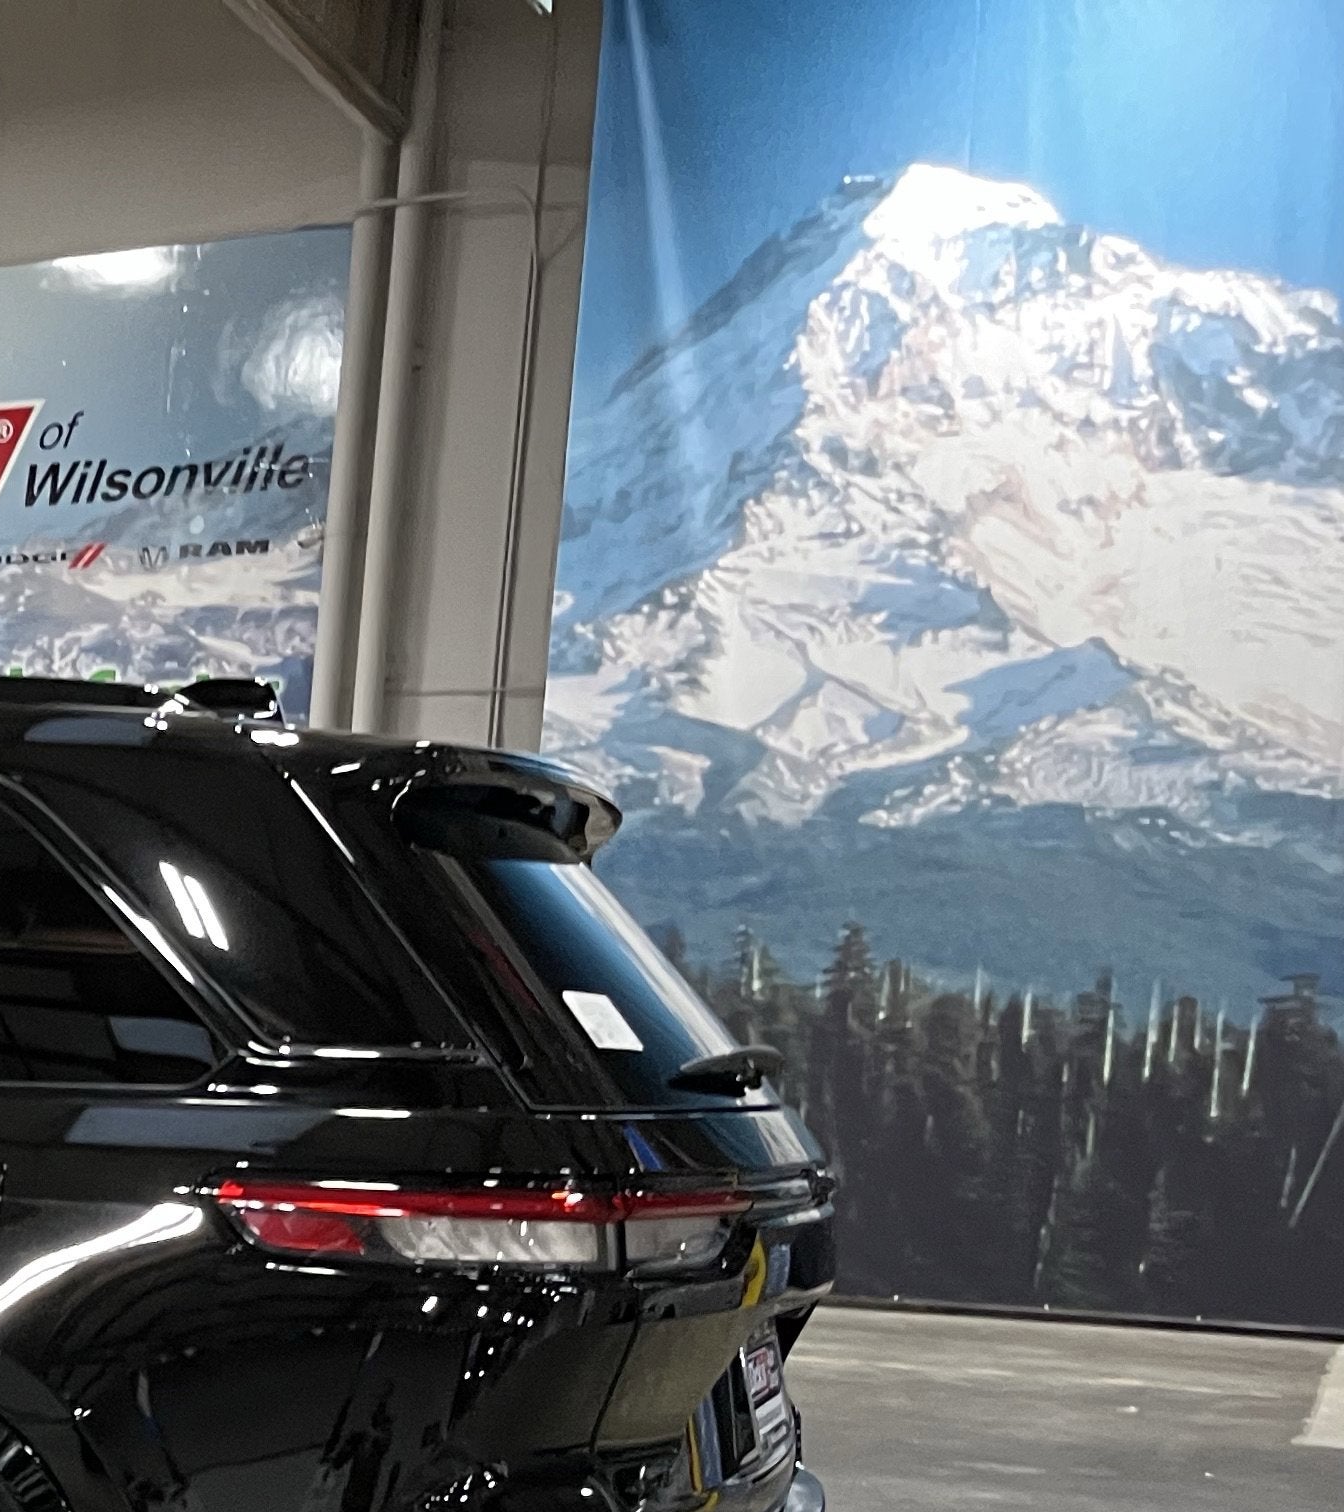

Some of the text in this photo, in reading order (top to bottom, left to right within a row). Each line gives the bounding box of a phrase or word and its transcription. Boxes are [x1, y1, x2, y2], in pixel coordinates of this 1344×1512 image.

[39, 410, 84, 450] of
[24, 443, 310, 507] Wilsonville
[179, 539, 270, 557] RAM
